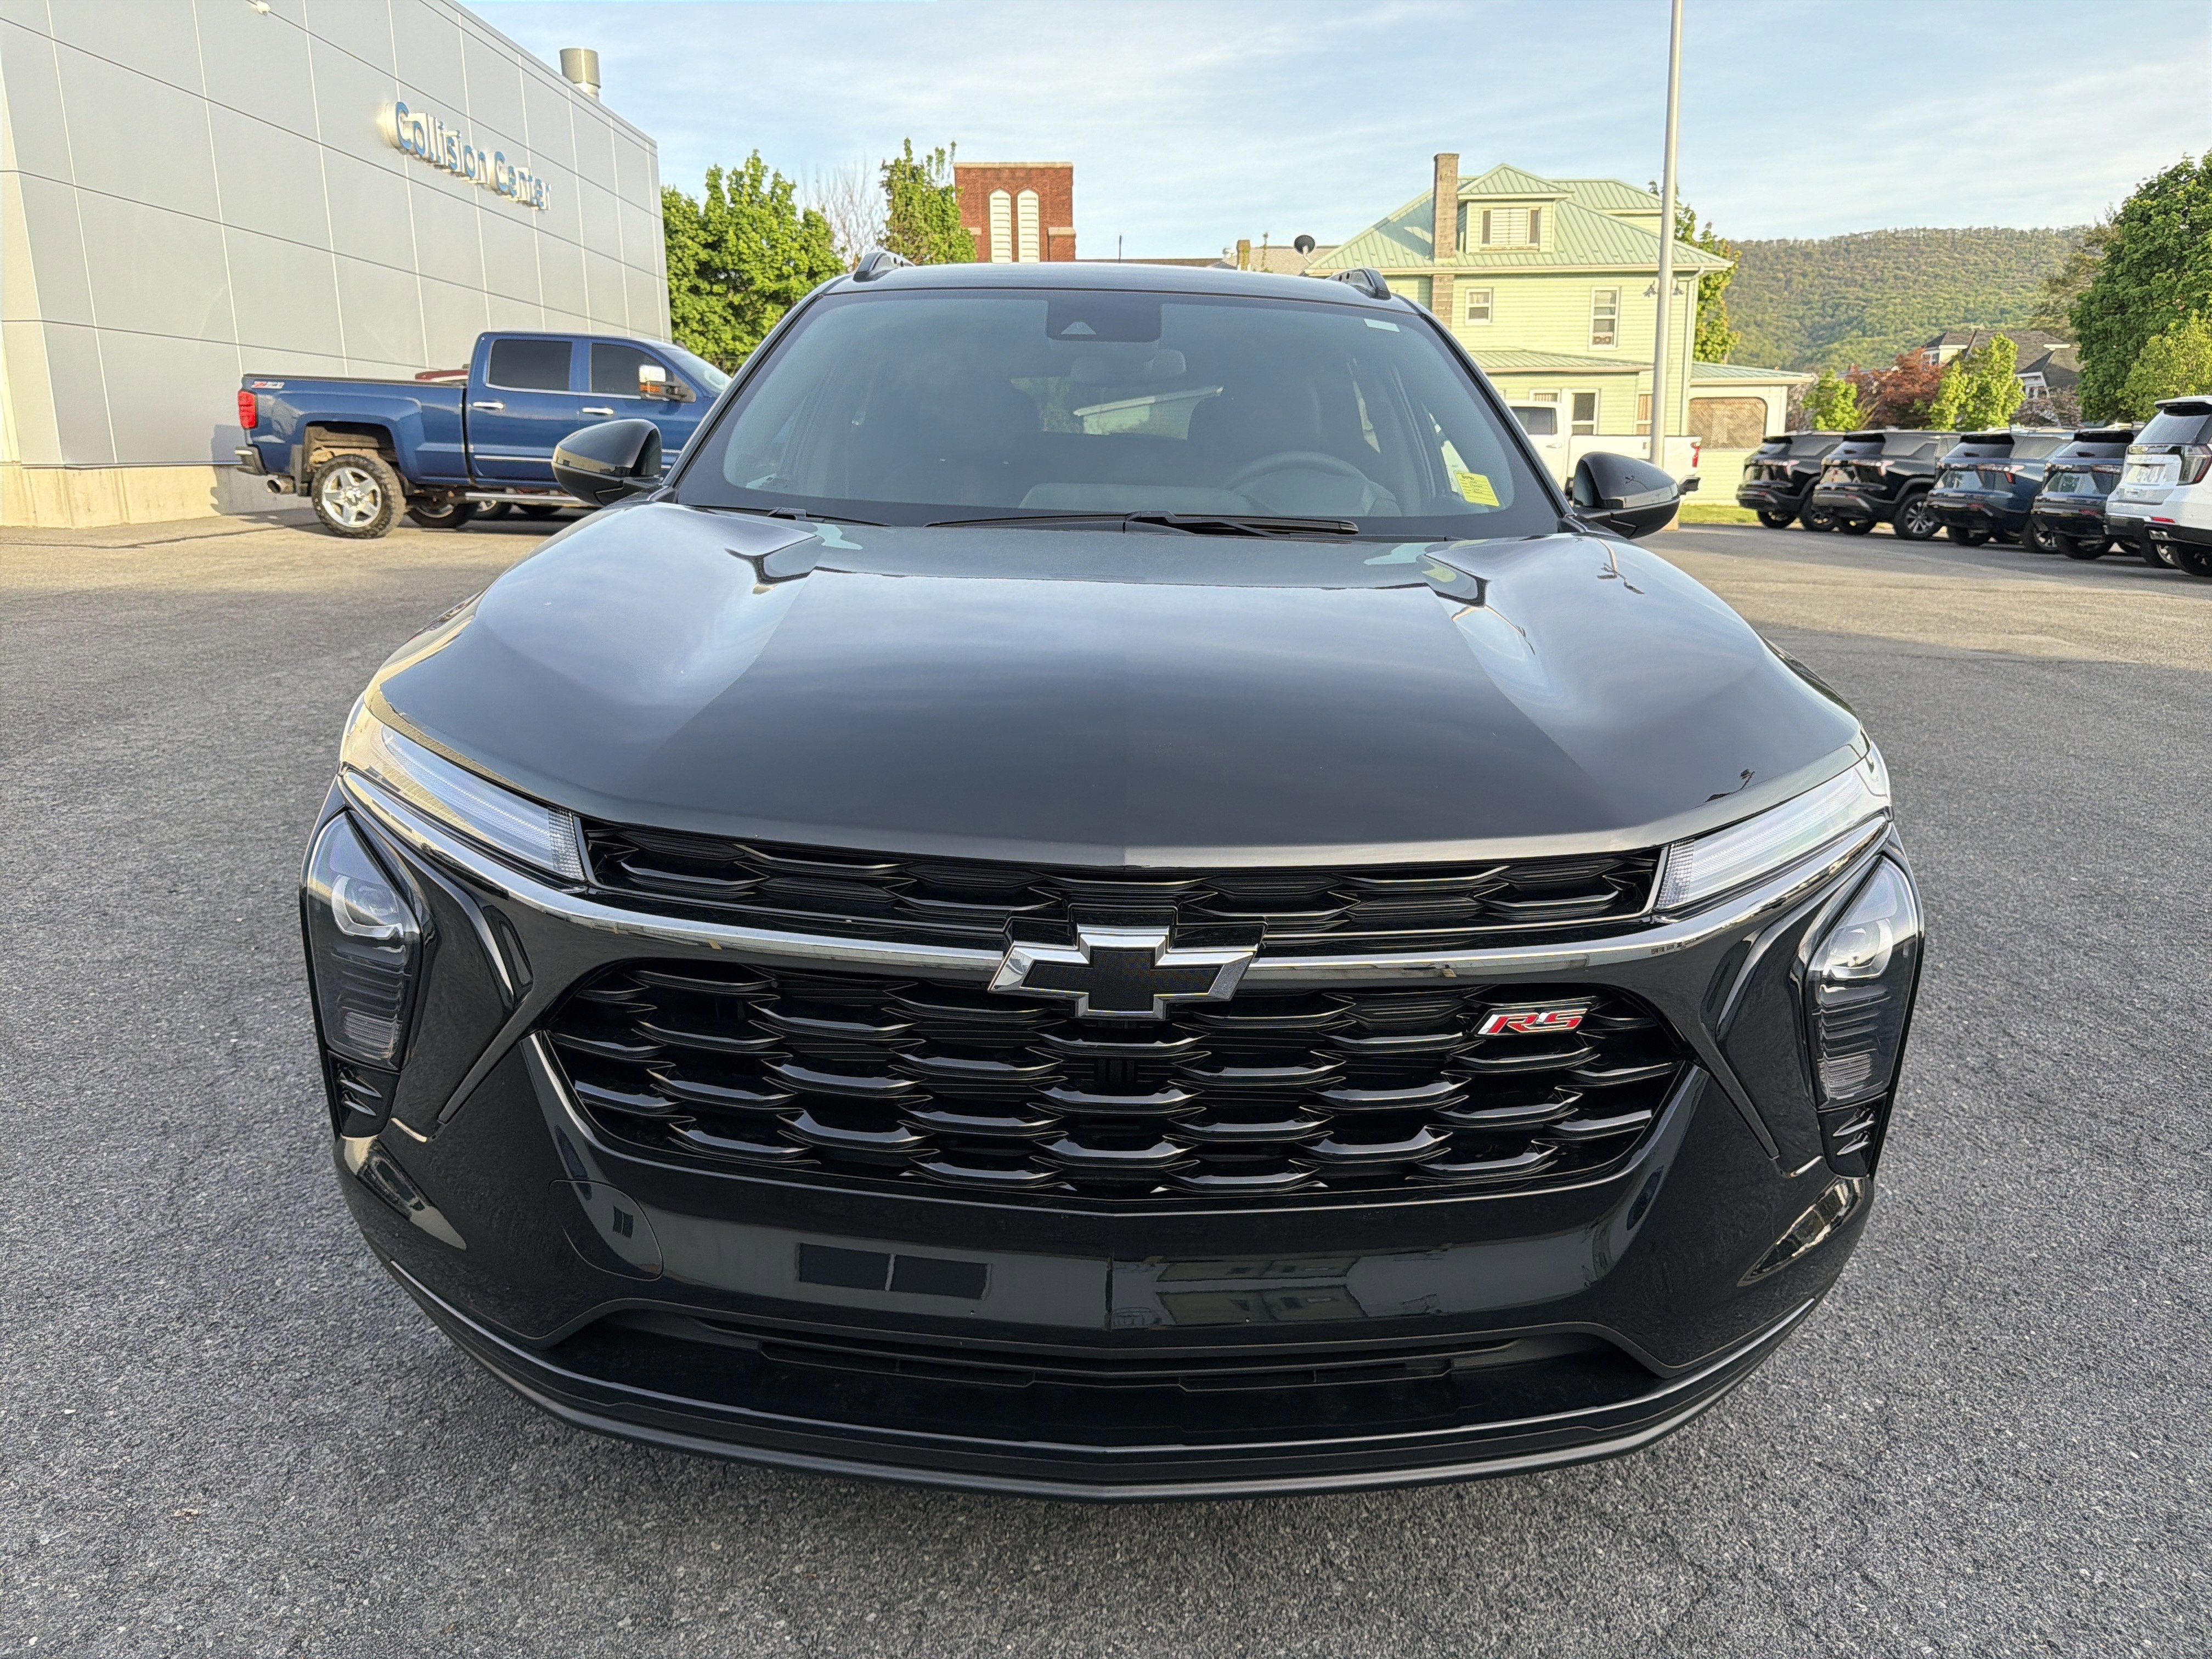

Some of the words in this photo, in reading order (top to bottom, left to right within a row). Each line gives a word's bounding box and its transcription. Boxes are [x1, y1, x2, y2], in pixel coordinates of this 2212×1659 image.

[394, 101, 490, 184] Collision
[494, 150, 551, 210] Center
[1477, 1008, 1588, 1035] RS
